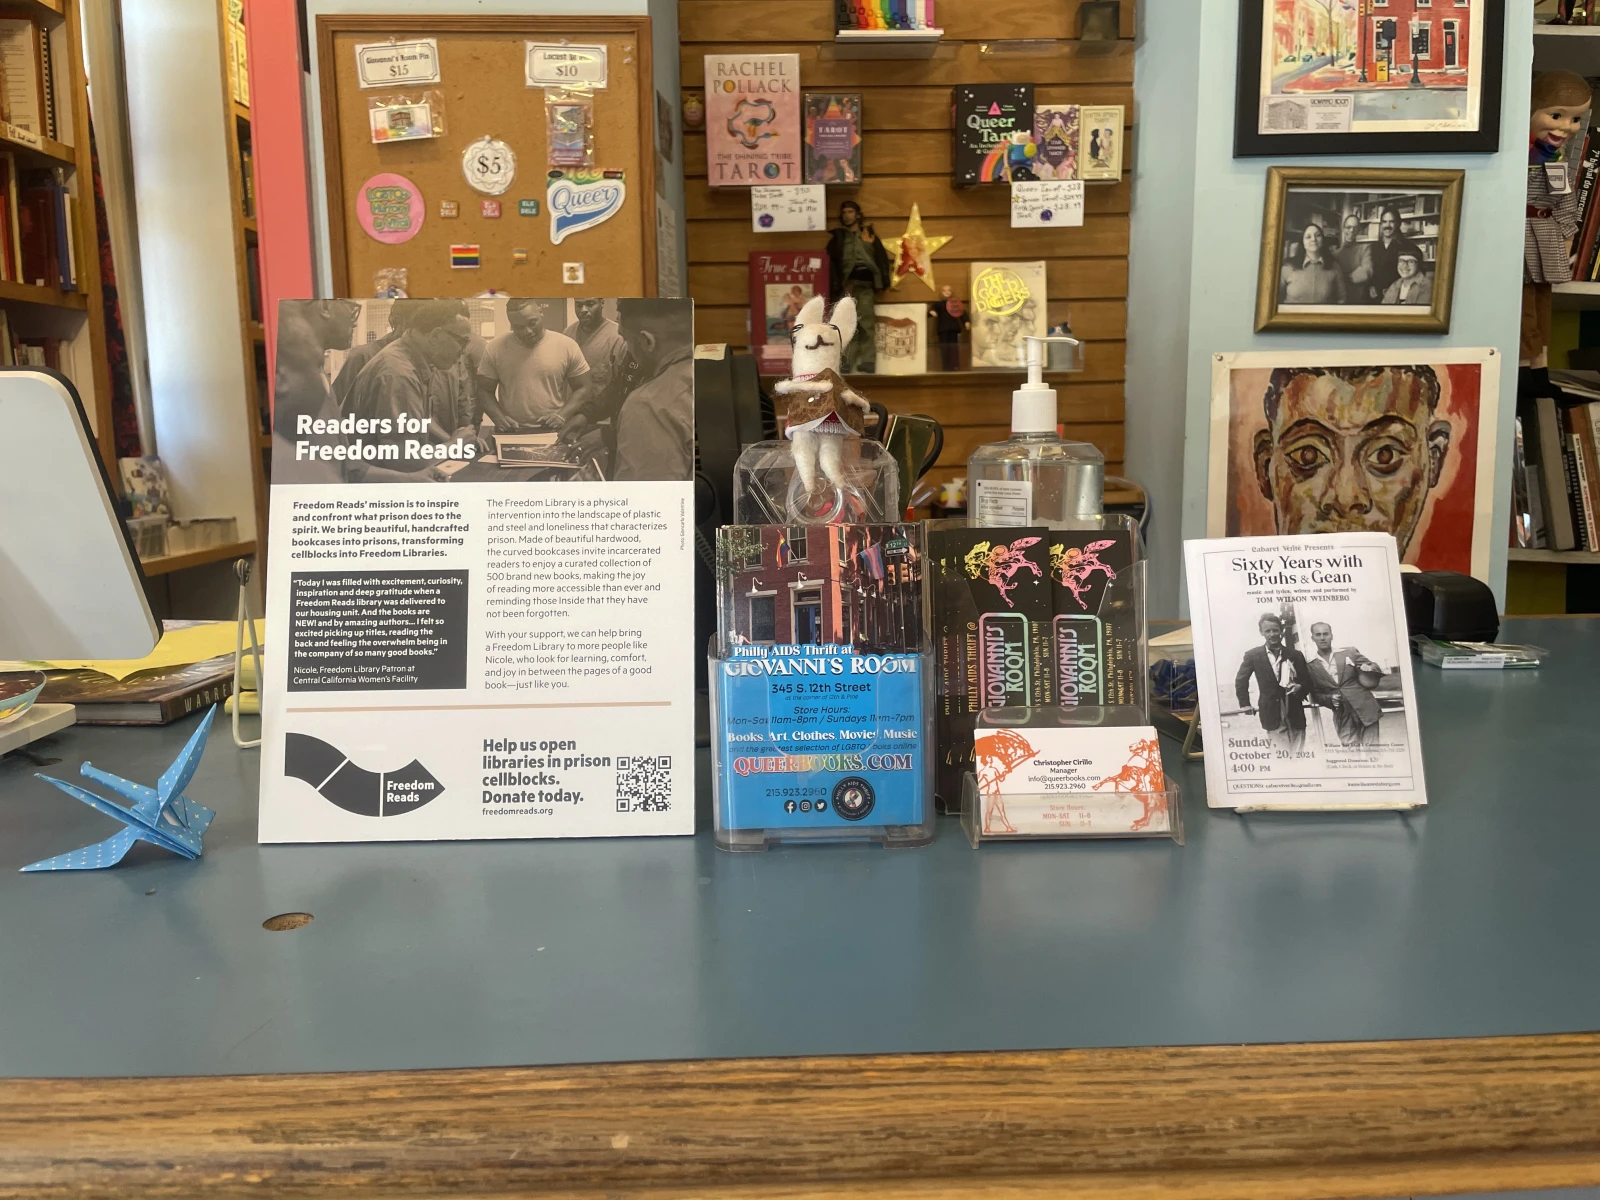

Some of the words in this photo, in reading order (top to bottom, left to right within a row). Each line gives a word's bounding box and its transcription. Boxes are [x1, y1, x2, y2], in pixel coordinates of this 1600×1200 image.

[389, 65, 409, 77] $15
[556, 66, 578, 77] $10
[717, 62, 786, 76] RACHEL
[713, 79, 792, 93] POLLACK
[966, 115, 1015, 129] Queer
[476, 156, 501, 175] $5
[716, 162, 795, 179] TAROT
[1583, 180, 1592, 189] do
[552, 187, 612, 215] Queer
[296, 413, 392, 435] Readers
[396, 412, 432, 434] for
[295, 438, 399, 461] Freedom
[404, 438, 476, 460] Reads
[427, 499, 458, 508] inspire
[545, 498, 576, 507] Library
[593, 498, 627, 507] physical
[1232, 556, 1274, 574] Sixty
[1279, 555, 1322, 569] Years
[1327, 554, 1363, 568] with
[1247, 571, 1297, 586] Bruhs
[1300, 575, 1309, 584] &
[1311, 570, 1352, 584] Gean
[966, 621, 978, 630] @
[734, 647, 767, 658] Philly
[771, 646, 800, 656] AIDS
[802, 645, 838, 656] Thrift
[841, 646, 853, 654] at
[966, 633, 976, 663] THRIFT
[726, 658, 843, 677] GIOVANNI'S
[851, 656, 917, 675] ROOM
[967, 664, 978, 683] AIDS
[985, 625, 1006, 711] GIOVANNI'S
[1005, 642, 1024, 692] ROOM
[1078, 644, 1098, 693] ROOM
[772, 683, 792, 693] 345
[796, 683, 807, 693] S.
[809, 683, 830, 693] 12th
[834, 682, 871, 692] Street
[968, 685, 978, 712] PHILLY
[820, 706, 851, 714] Hours:
[819, 715, 824, 724] /
[826, 714, 867, 725] Sundays
[883, 729, 917, 739] Music
[483, 738, 516, 753] Help
[520, 741, 536, 751] us
[539, 740, 576, 752] open
[1228, 737, 1277, 749] Sunday,
[482, 754, 544, 770] libraries
[548, 754, 560, 767] in
[564, 754, 610, 769] prison
[1229, 751, 1272, 761] October
[1276, 750, 1292, 760] 20,
[734, 754, 913, 774] QUEERBOOKS.COM
[1231, 764, 1255, 773] 4:00
[482, 771, 559, 787] cellblocks.
[482, 790, 535, 803] Donate
[538, 788, 583, 804] today.
[766, 786, 827, 798] 215.923.2960
